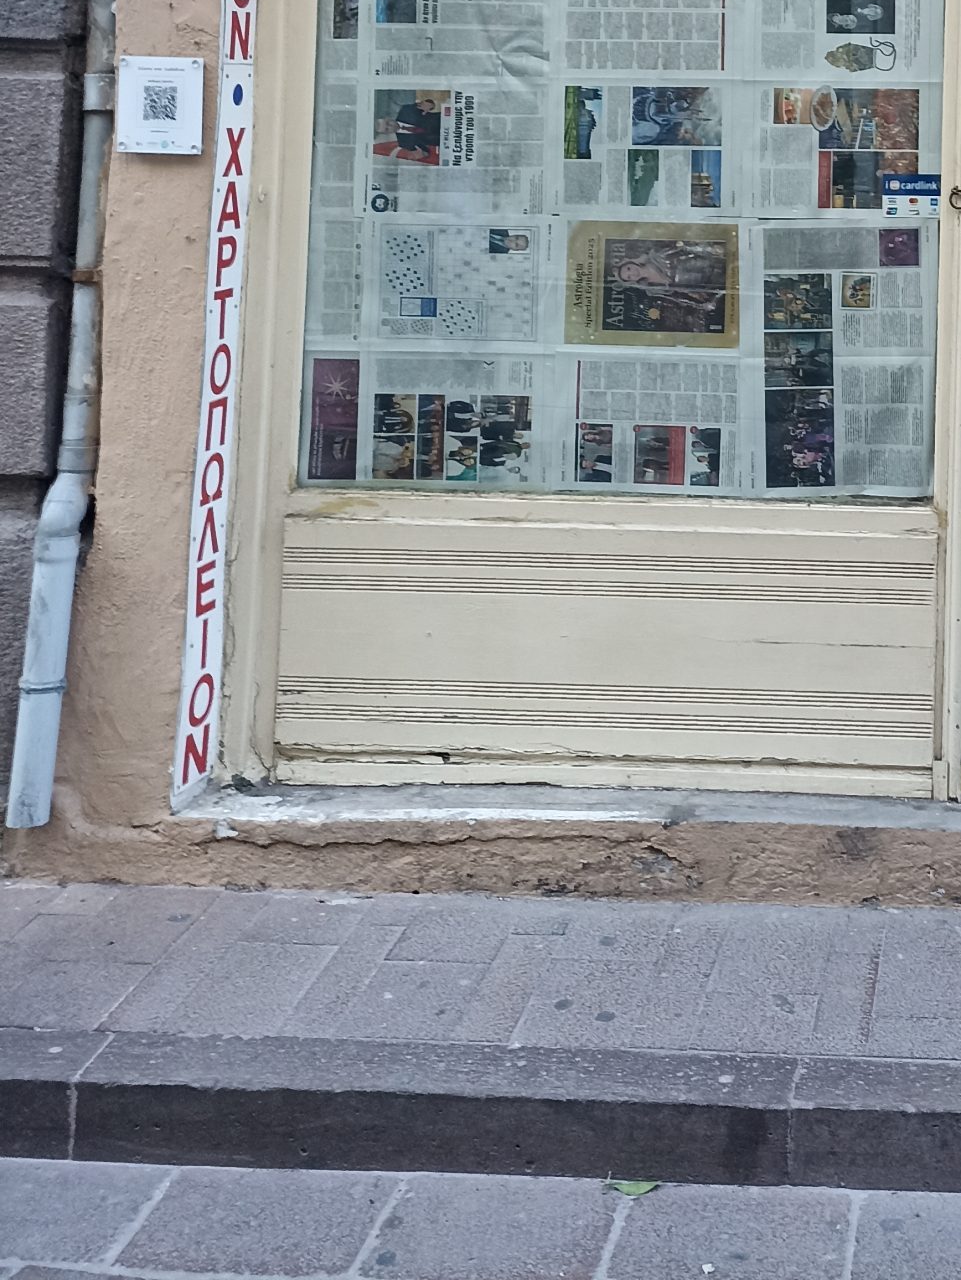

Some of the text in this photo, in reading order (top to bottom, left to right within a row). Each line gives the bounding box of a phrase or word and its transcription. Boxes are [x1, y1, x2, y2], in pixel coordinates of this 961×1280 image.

[454, 90, 464, 105] την
[452, 155, 462, 166] Να
[901, 180, 938, 190] cardlink
[182, 127, 246, 785] ΧΑΡΤΟΠΩΛΕΙΟΝ
